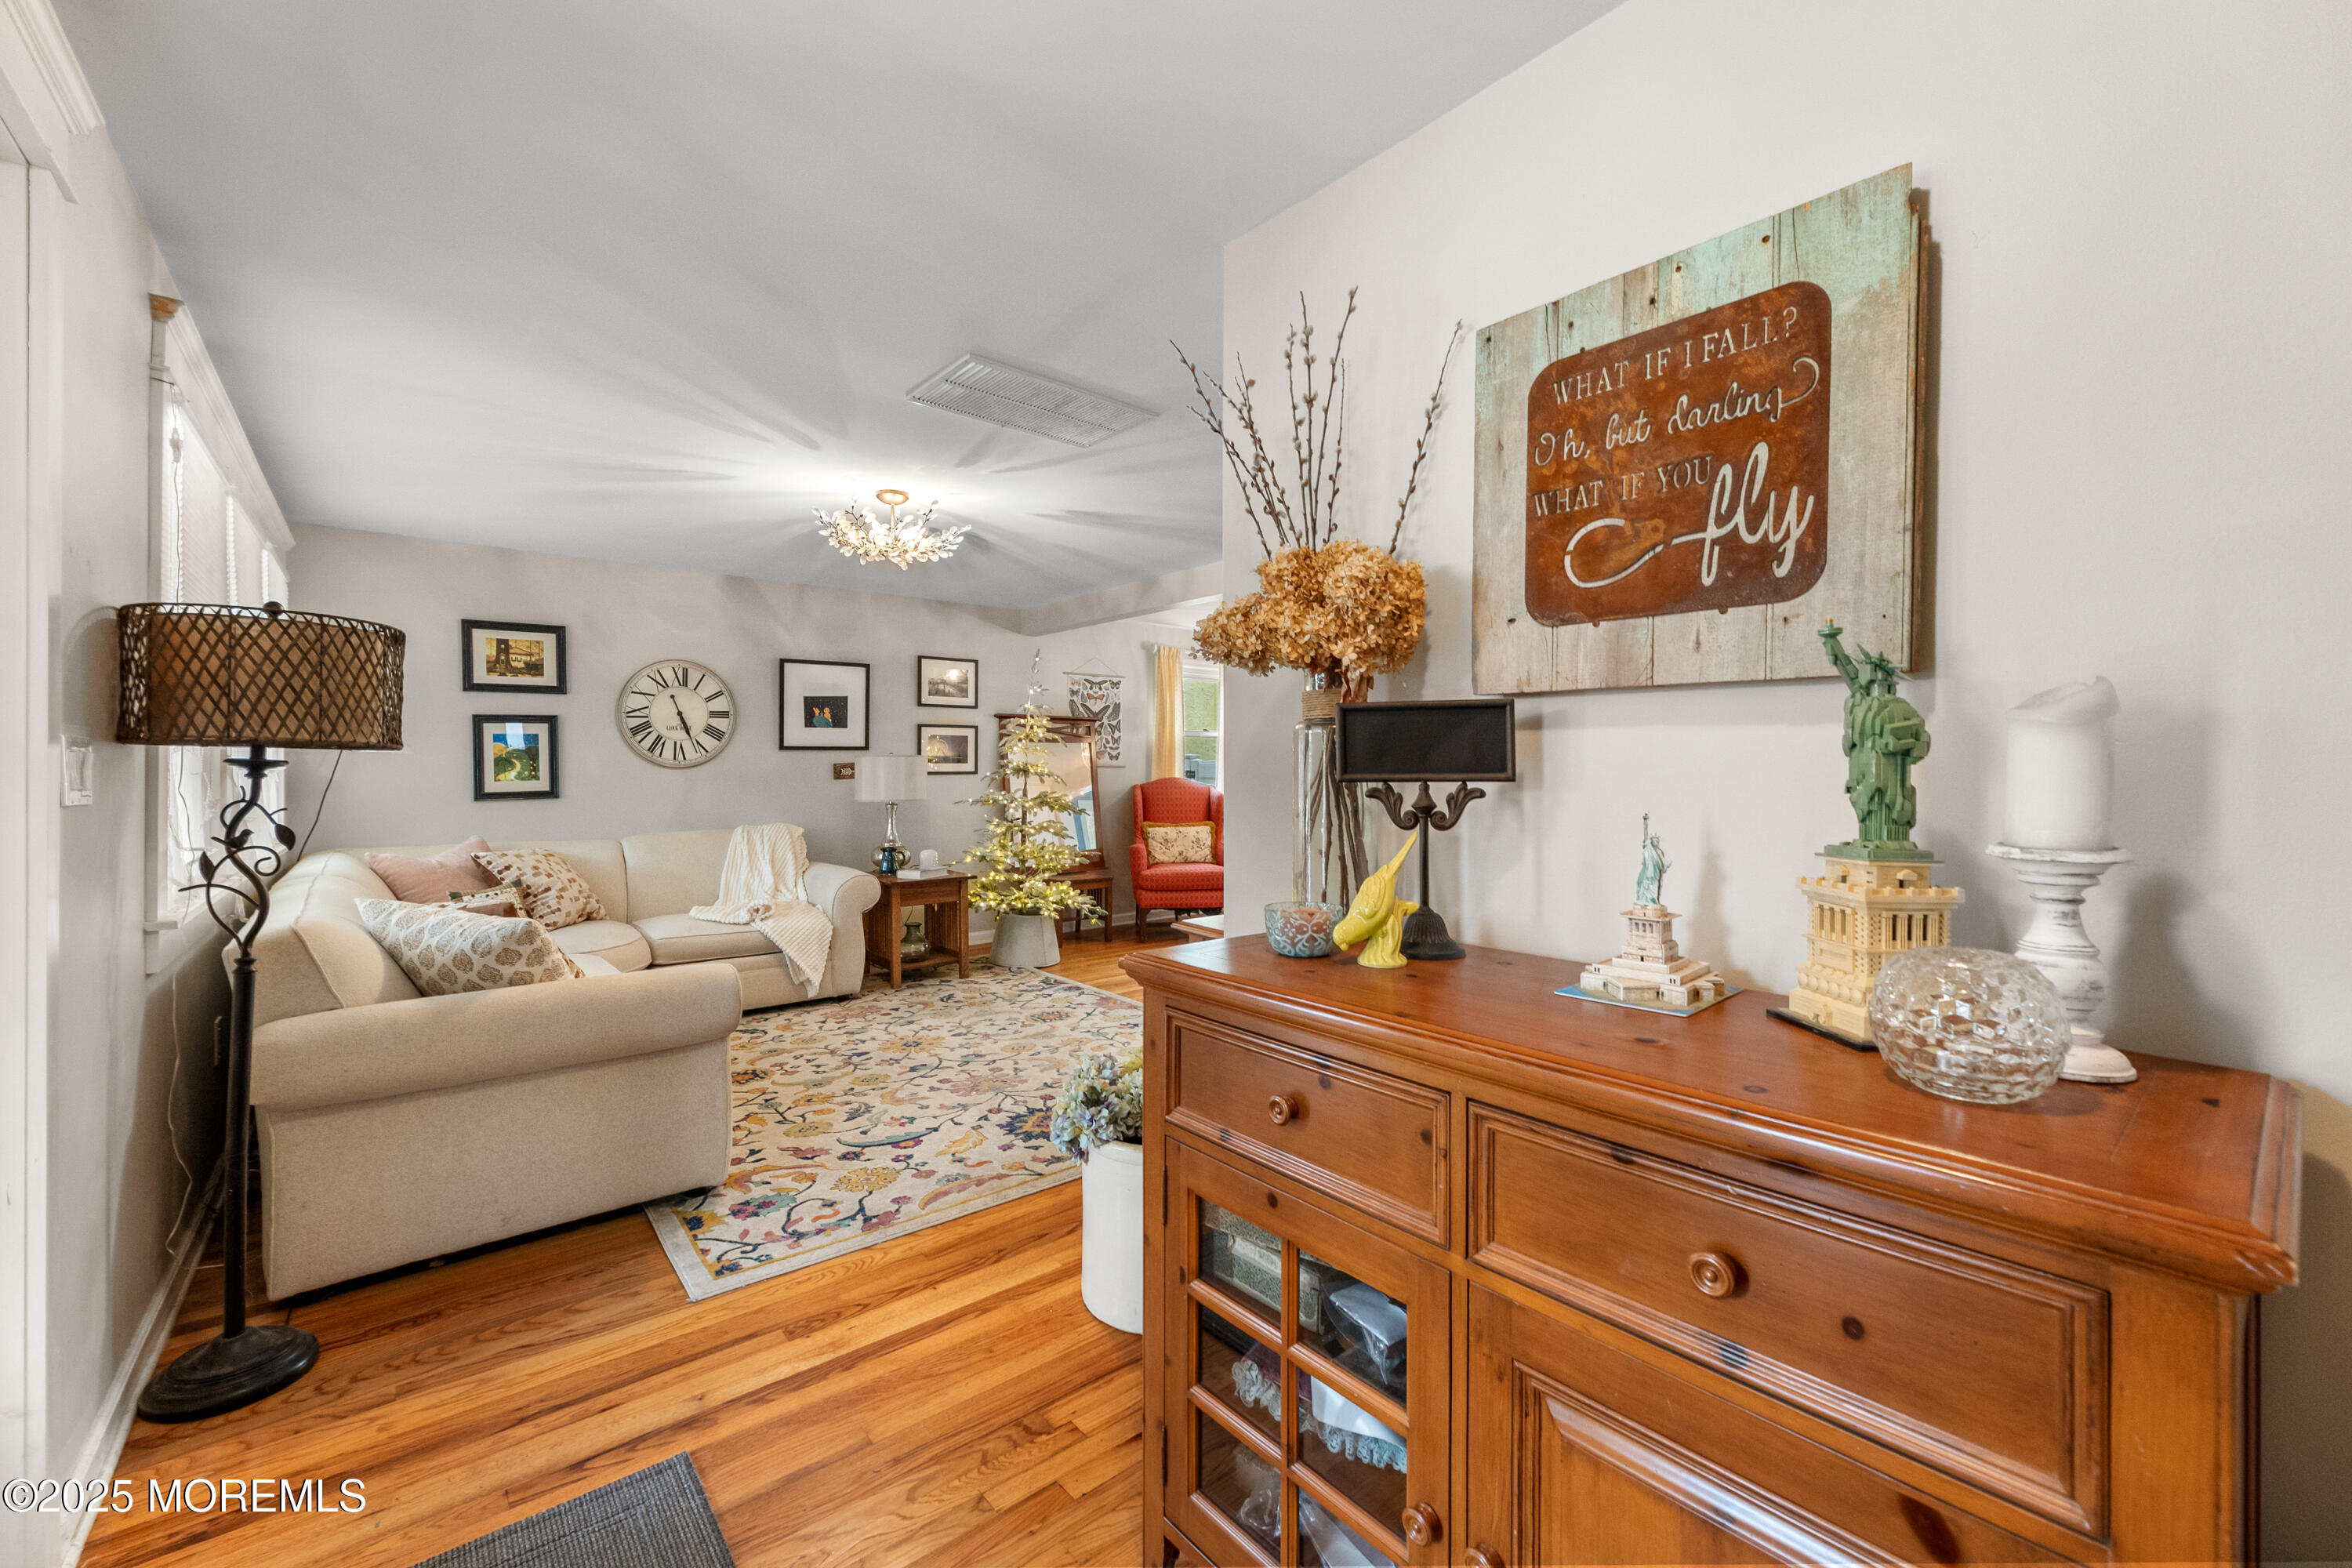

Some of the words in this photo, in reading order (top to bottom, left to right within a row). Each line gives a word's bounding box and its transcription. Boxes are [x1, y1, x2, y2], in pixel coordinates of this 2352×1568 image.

[1553, 361, 1629, 405] WHAT
[1645, 347, 1671, 380] IF
[1684, 340, 1693, 368] I
[1702, 307, 1797, 362] FALL?
[1535, 428, 1591, 466] Oh,
[1606, 410, 1650, 449] but
[1668, 358, 1819, 434] darling
[1534, 480, 1603, 517] WHAT
[1621, 472, 1644, 500] IF
[1657, 456, 1712, 492] YOU
[1671, 441, 1814, 587] fly
